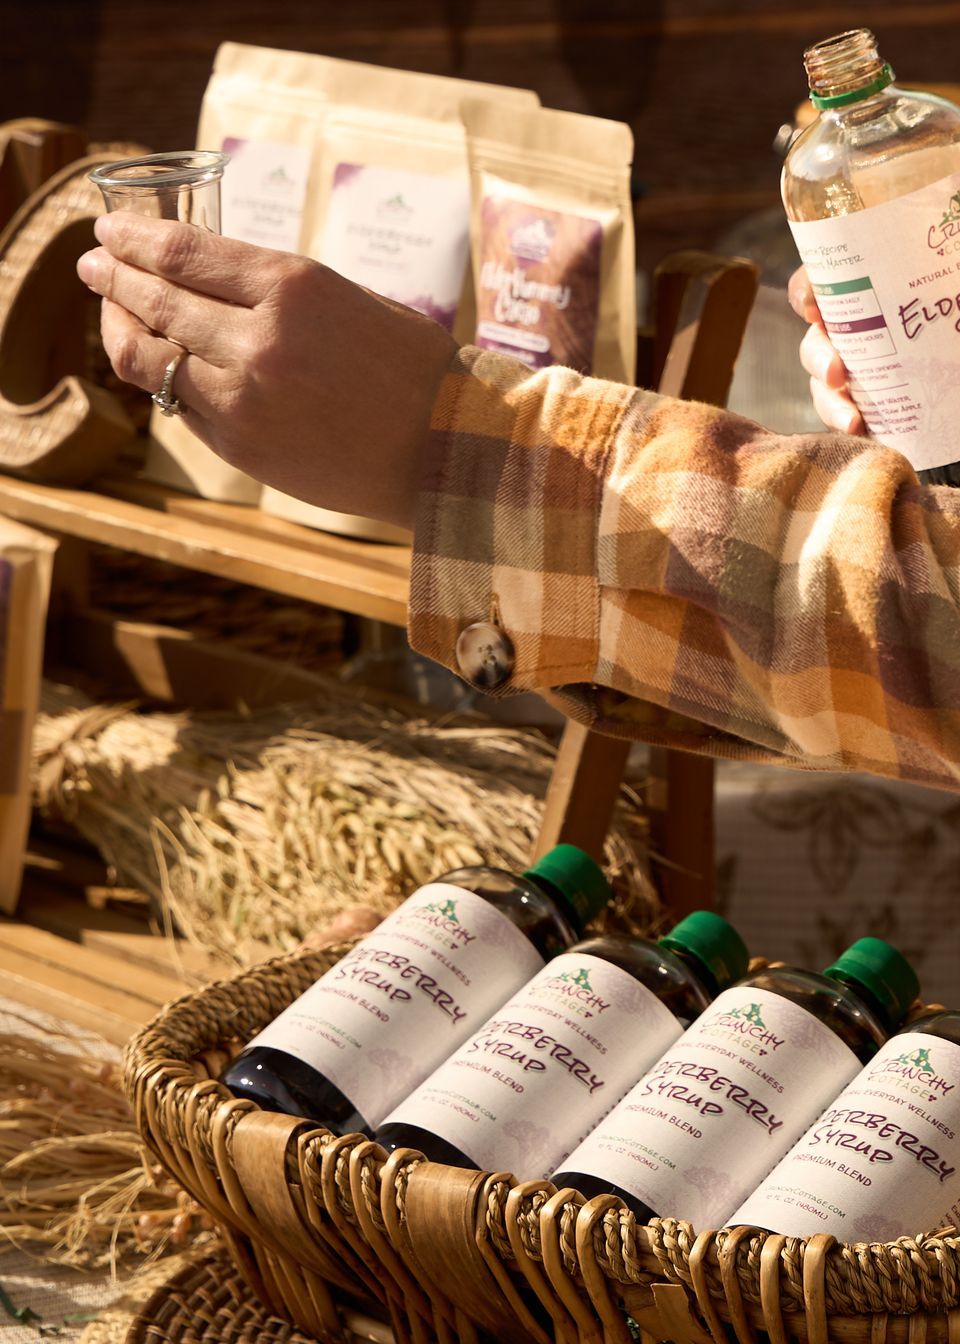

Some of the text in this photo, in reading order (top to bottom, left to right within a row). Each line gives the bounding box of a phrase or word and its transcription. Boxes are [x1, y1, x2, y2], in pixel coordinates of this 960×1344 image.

[908, 266, 955, 289] NATURAL
[335, 960, 412, 1001] SYRUP
[358, 998, 390, 1023] BLEND
[467, 1033, 546, 1072] SYRUP
[564, 1018, 608, 1055] WELLNESS
[492, 1070, 525, 1094] BLEND
[738, 1056, 785, 1094] WELLNESS
[870, 1057, 955, 1096] CRUNCHY
[640, 1075, 724, 1116] SYRUP
[862, 1088, 907, 1107] EVERYDAY
[907, 1102, 957, 1140] WELLNESS
[668, 1115, 703, 1139] BLEND
[808, 1123, 894, 1164] SYRUP
[836, 1163, 872, 1187] BLEND
